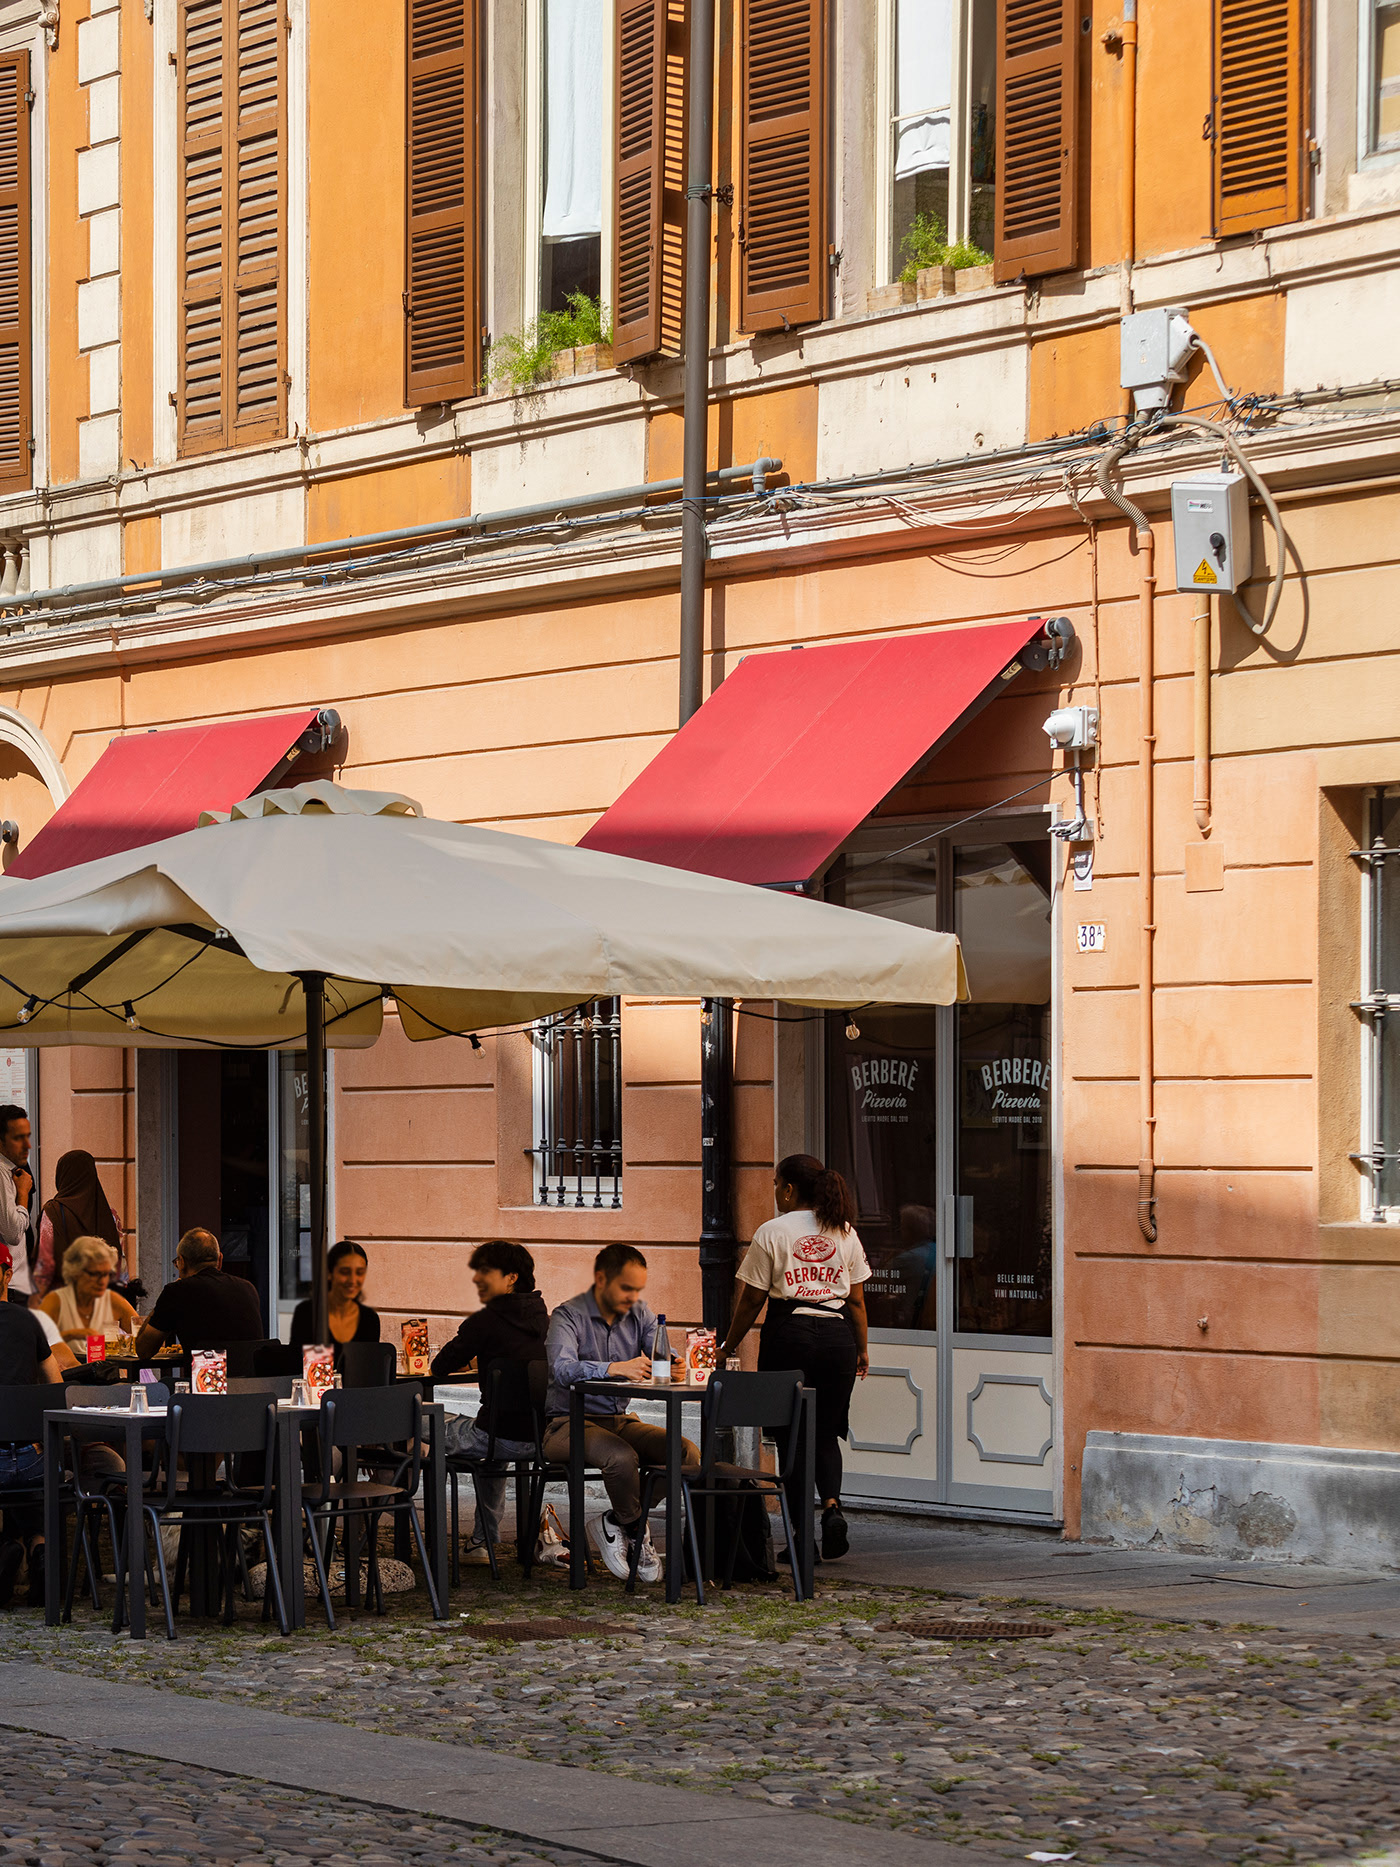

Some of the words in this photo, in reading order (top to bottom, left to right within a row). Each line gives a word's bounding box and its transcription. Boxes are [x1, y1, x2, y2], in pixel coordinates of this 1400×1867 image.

[851, 1059, 919, 1091] BERBERÈ
[981, 1058, 1052, 1091] BERBERÈ
[861, 1089, 907, 1109] Pizzeria
[991, 1088, 1041, 1109] Pizzeria
[784, 1265, 844, 1286] BERBERÈ
[997, 1274, 1014, 1283] BELLE
[1017, 1275, 1034, 1284] BIRRE
[793, 1285, 831, 1298] Pizzeria
[864, 1283, 887, 1292] ORGANIC
[889, 1284, 906, 1293] FLOUR
[994, 1289, 1007, 1298] VINI
[1009, 1290, 1037, 1299] NATURALI
